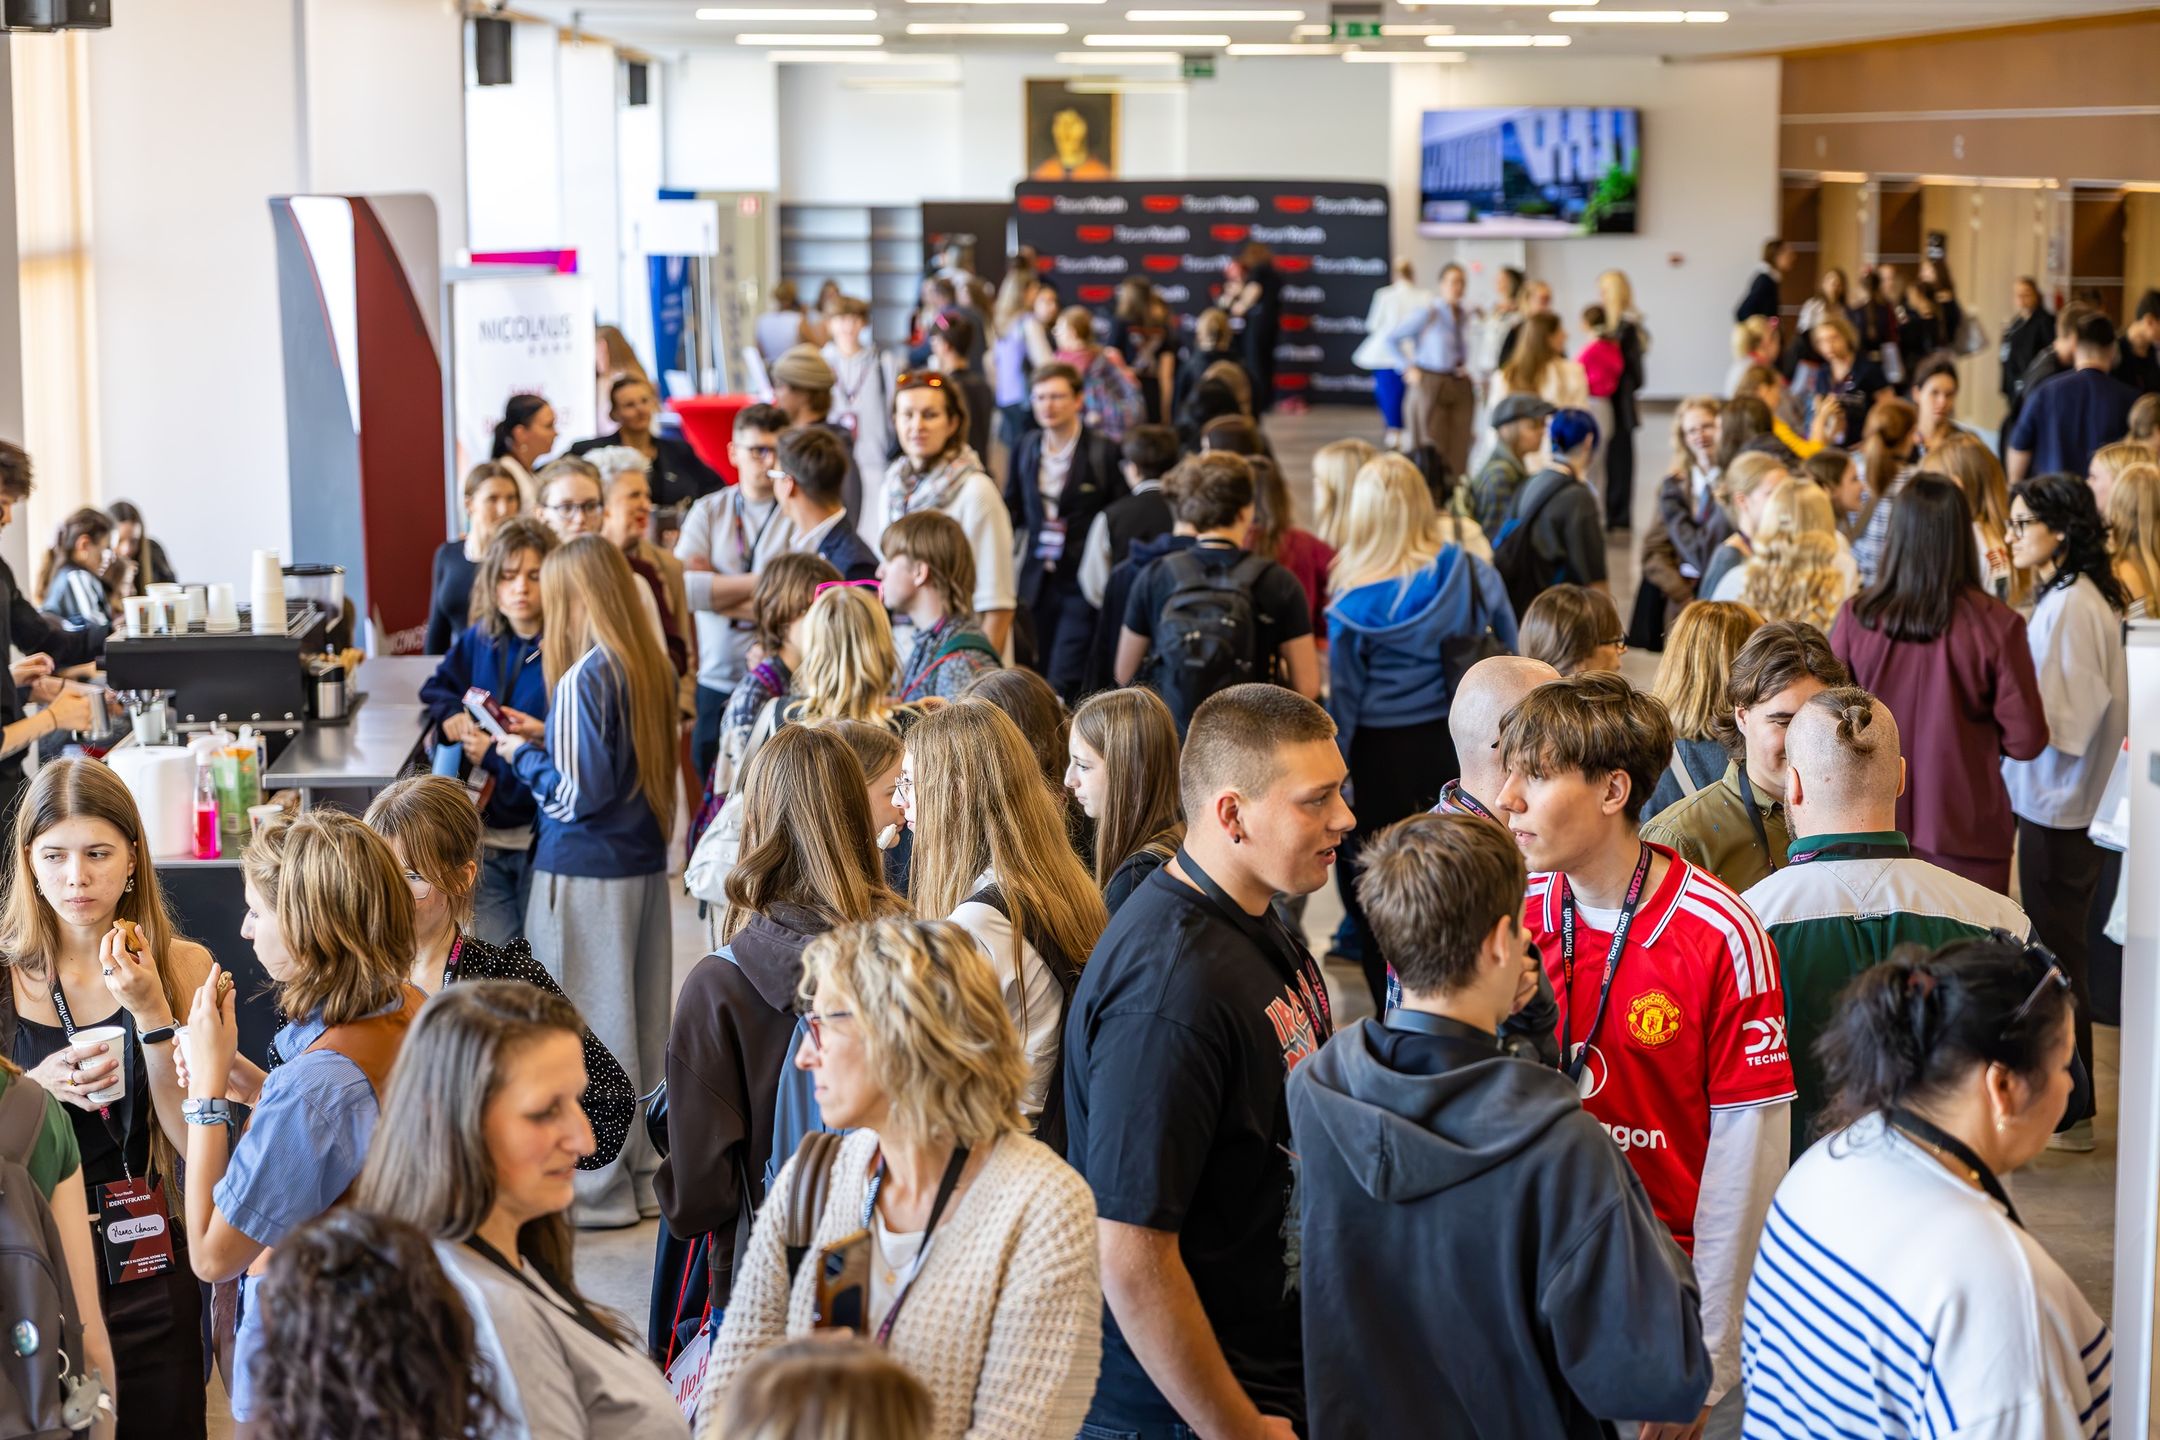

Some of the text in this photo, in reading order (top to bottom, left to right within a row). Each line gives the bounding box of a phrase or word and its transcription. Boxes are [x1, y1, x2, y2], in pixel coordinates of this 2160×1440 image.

[1562, 907, 1572, 959] TorunYouth
[1607, 911, 1631, 961] TorunYouth
[53, 992, 77, 1037] TorunYouth
[1635, 995, 1676, 1019] MANCHESTER
[1635, 1031, 1666, 1044] UNITED
[108, 1194, 151, 1208] IDENTYFIKATOR
